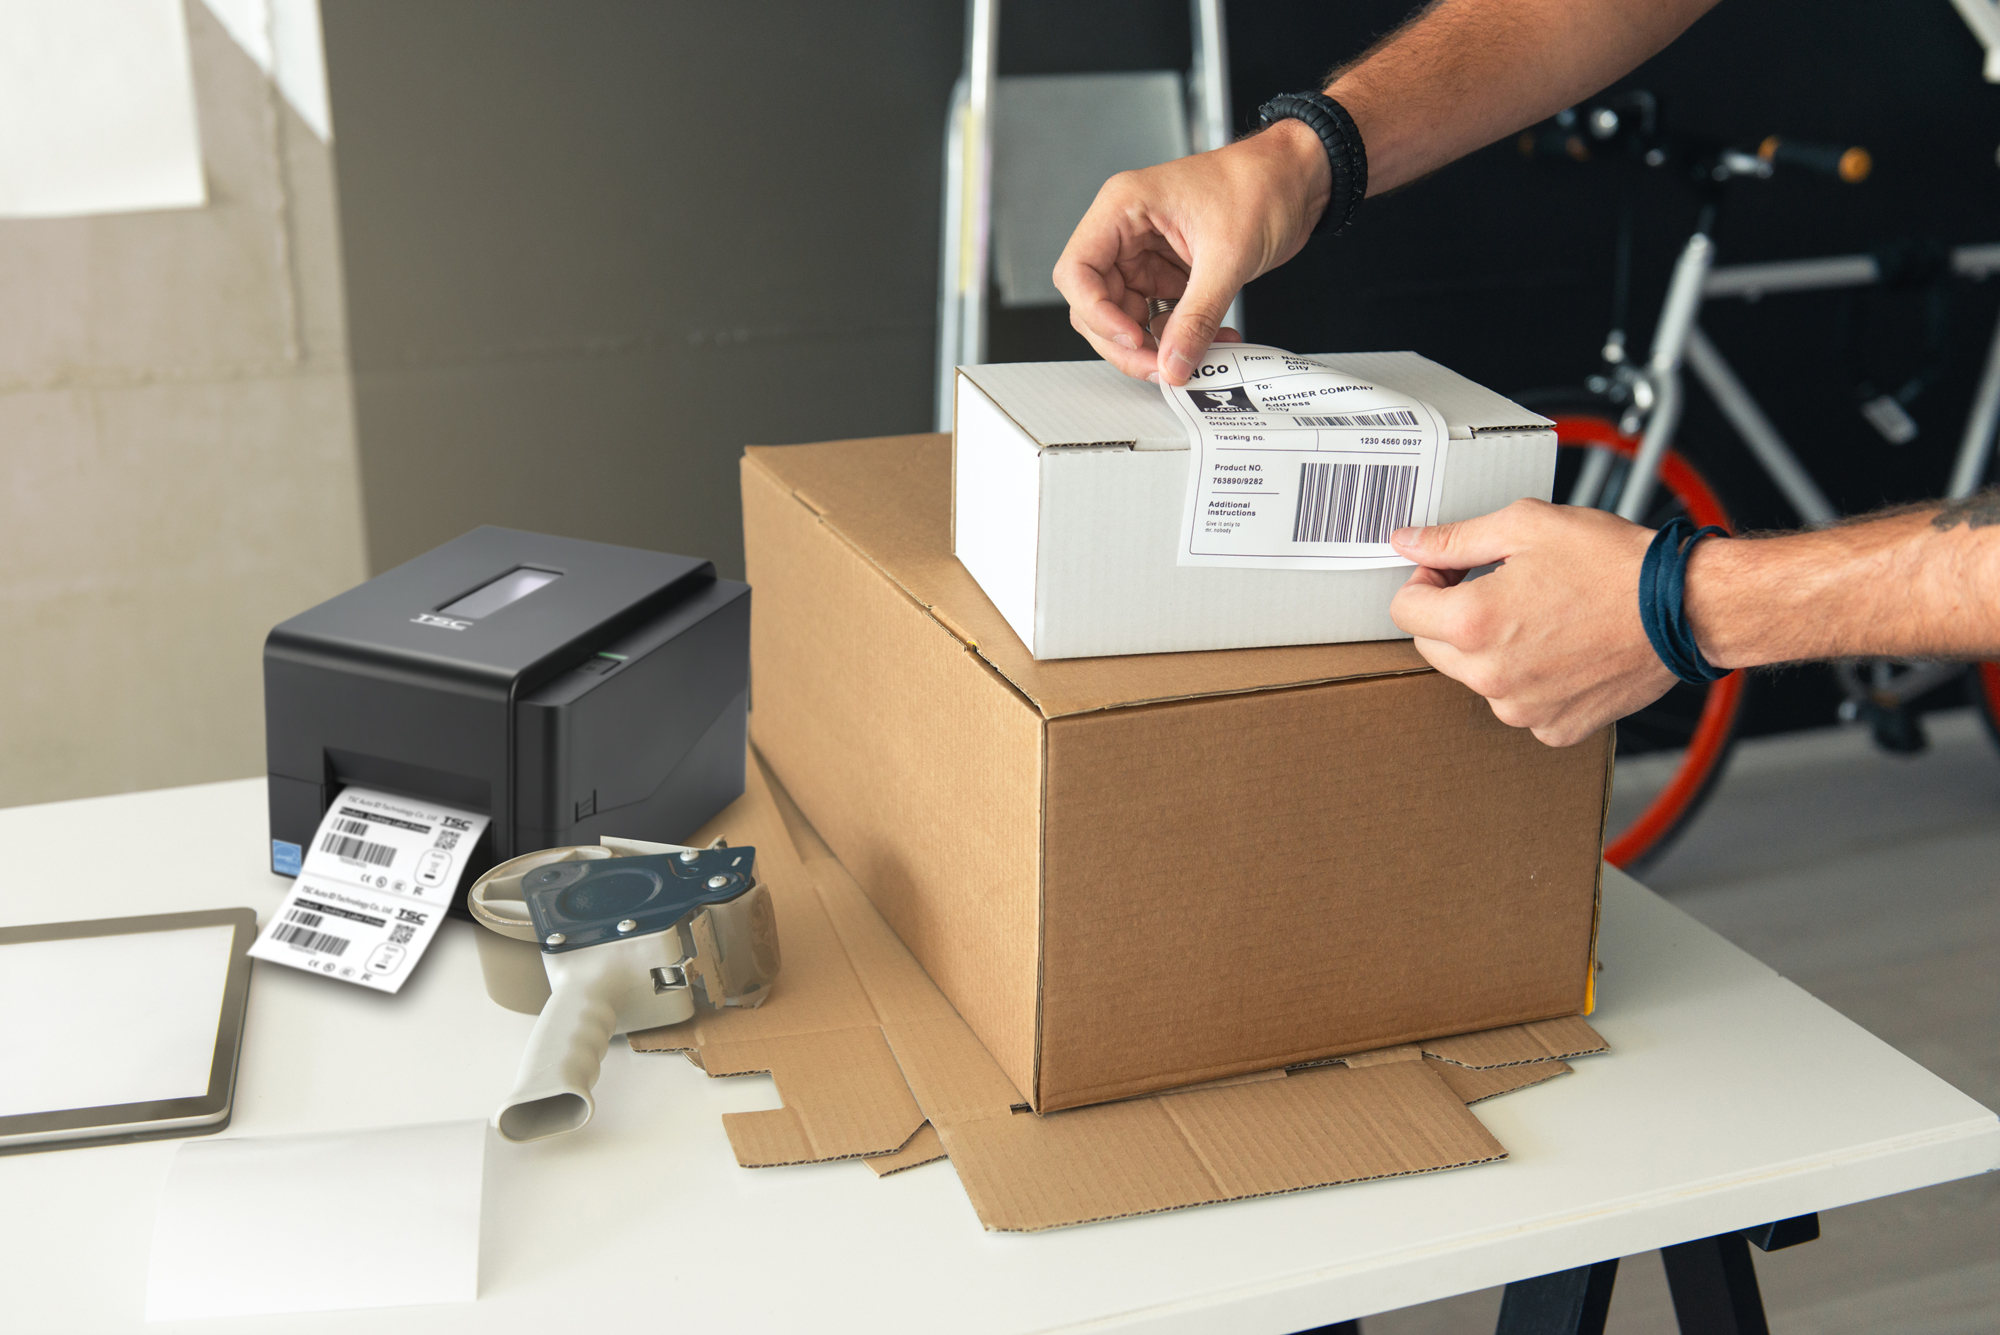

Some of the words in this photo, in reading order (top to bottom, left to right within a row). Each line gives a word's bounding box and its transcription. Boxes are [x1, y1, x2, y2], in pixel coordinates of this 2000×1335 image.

[1255, 383, 1273, 391] To:
[1262, 390, 1317, 402] ANOTHER
[1319, 384, 1374, 396] COMPANY
[1214, 434, 1250, 442] Tracking
[1360, 437, 1379, 445] 1230
[1402, 438, 1422, 446] 0937
[1214, 463, 1247, 471] Product
[1248, 464, 1263, 472] NO.
[1212, 477, 1264, 485] 763890/9282
[410, 613, 474, 631] TSC
[441, 815, 474, 831] TSC
[313, 888, 328, 898] Auto
[336, 894, 370, 909] Technology
[395, 908, 429, 926] TSC
